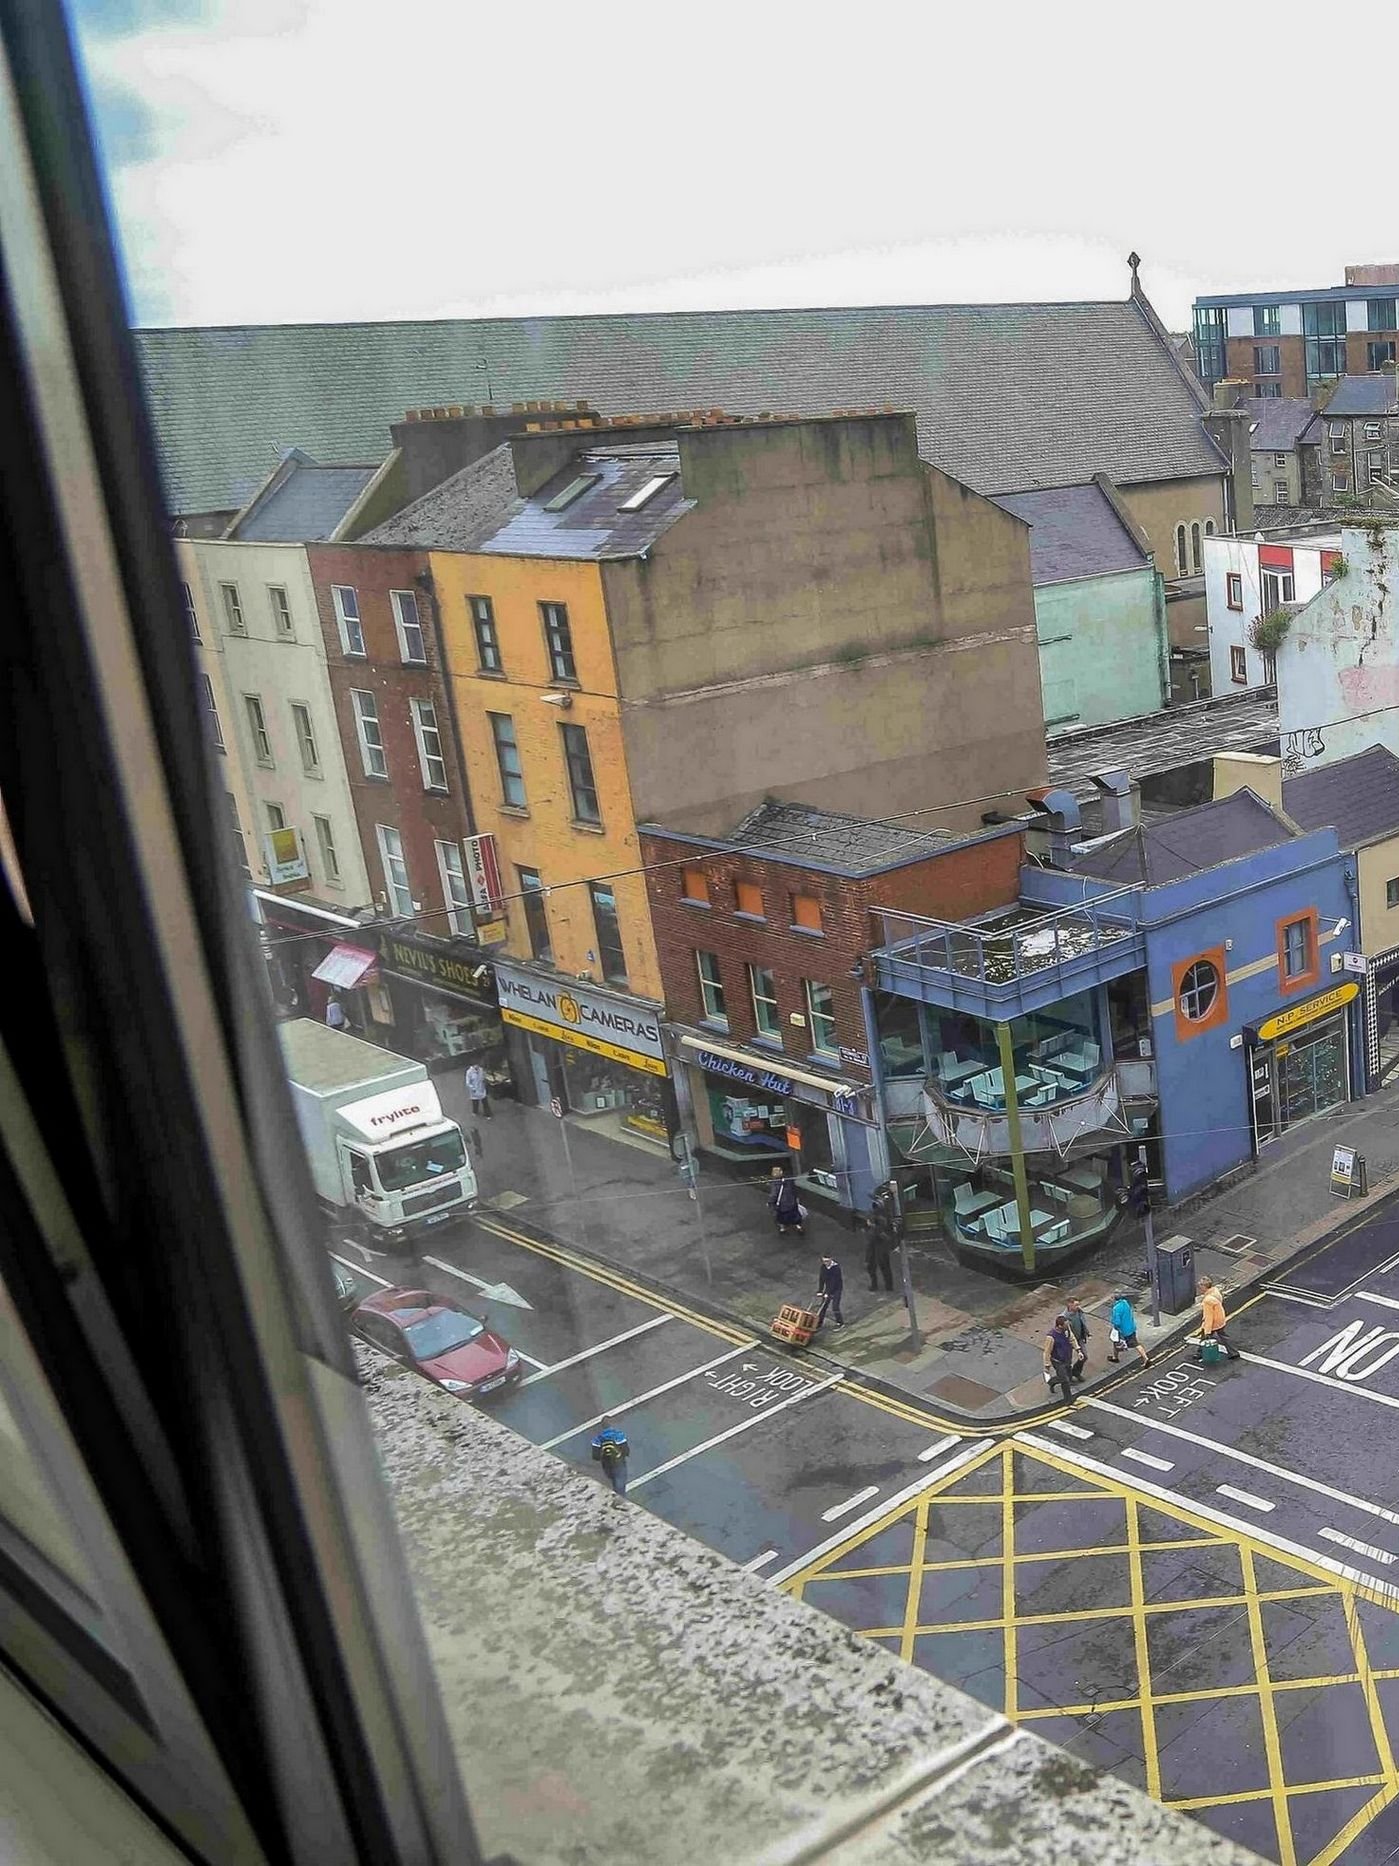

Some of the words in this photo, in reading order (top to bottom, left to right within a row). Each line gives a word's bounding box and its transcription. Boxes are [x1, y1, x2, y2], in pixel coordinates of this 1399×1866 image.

[471, 839, 483, 872] PHOTO
[498, 977, 557, 1010] WHELAN
[580, 1005, 659, 1042] CAMERAS
[1300, 991, 1342, 1015] SERVICE
[698, 1052, 756, 1084] Chicken
[760, 1071, 793, 1095] Hut
[707, 1373, 779, 1408] RIGHT
[755, 1366, 814, 1396] LOOK
[1140, 1362, 1205, 1400] LOOK
[1157, 1378, 1217, 1419] LEFT
